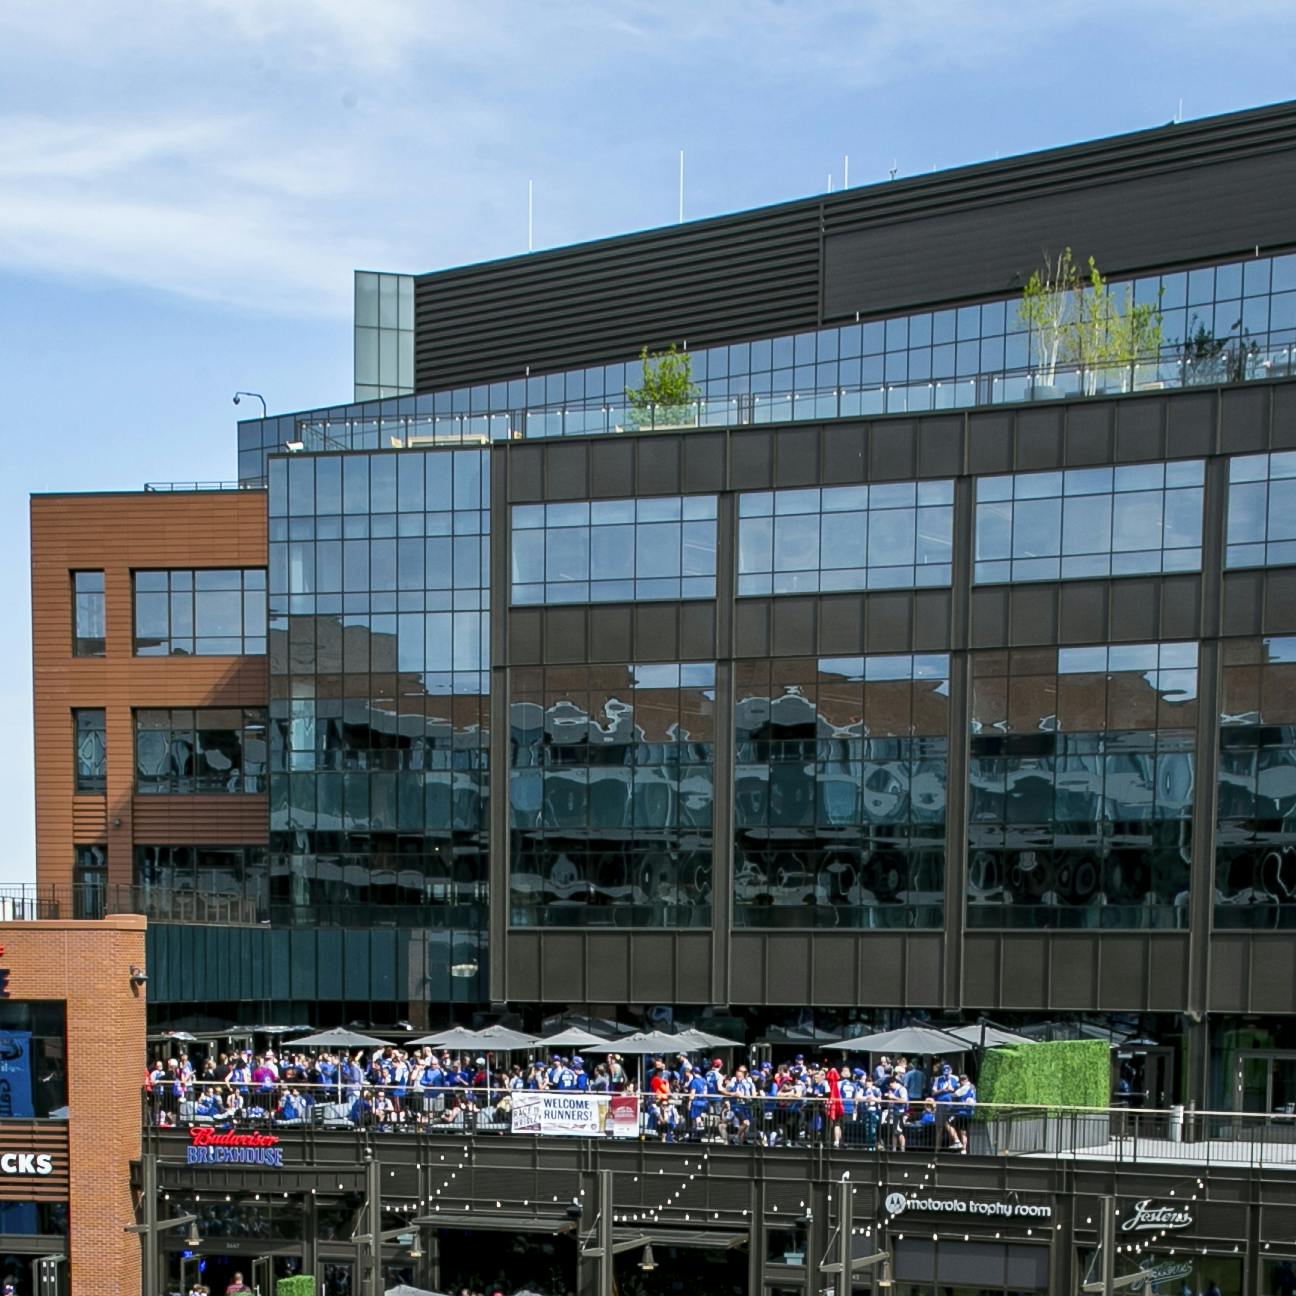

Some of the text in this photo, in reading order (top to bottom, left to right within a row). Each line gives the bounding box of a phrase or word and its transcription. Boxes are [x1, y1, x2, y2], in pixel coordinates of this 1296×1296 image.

[544, 1098, 590, 1110] WELCOME
[544, 1110, 593, 1121] RUNNERS!
[188, 1127, 280, 1147] Budweiser
[186, 1145, 284, 1167] BRICKHOUSE
[906, 1197, 1052, 1217] motorola trophy room
[1121, 1199, 1193, 1231] Jostens
